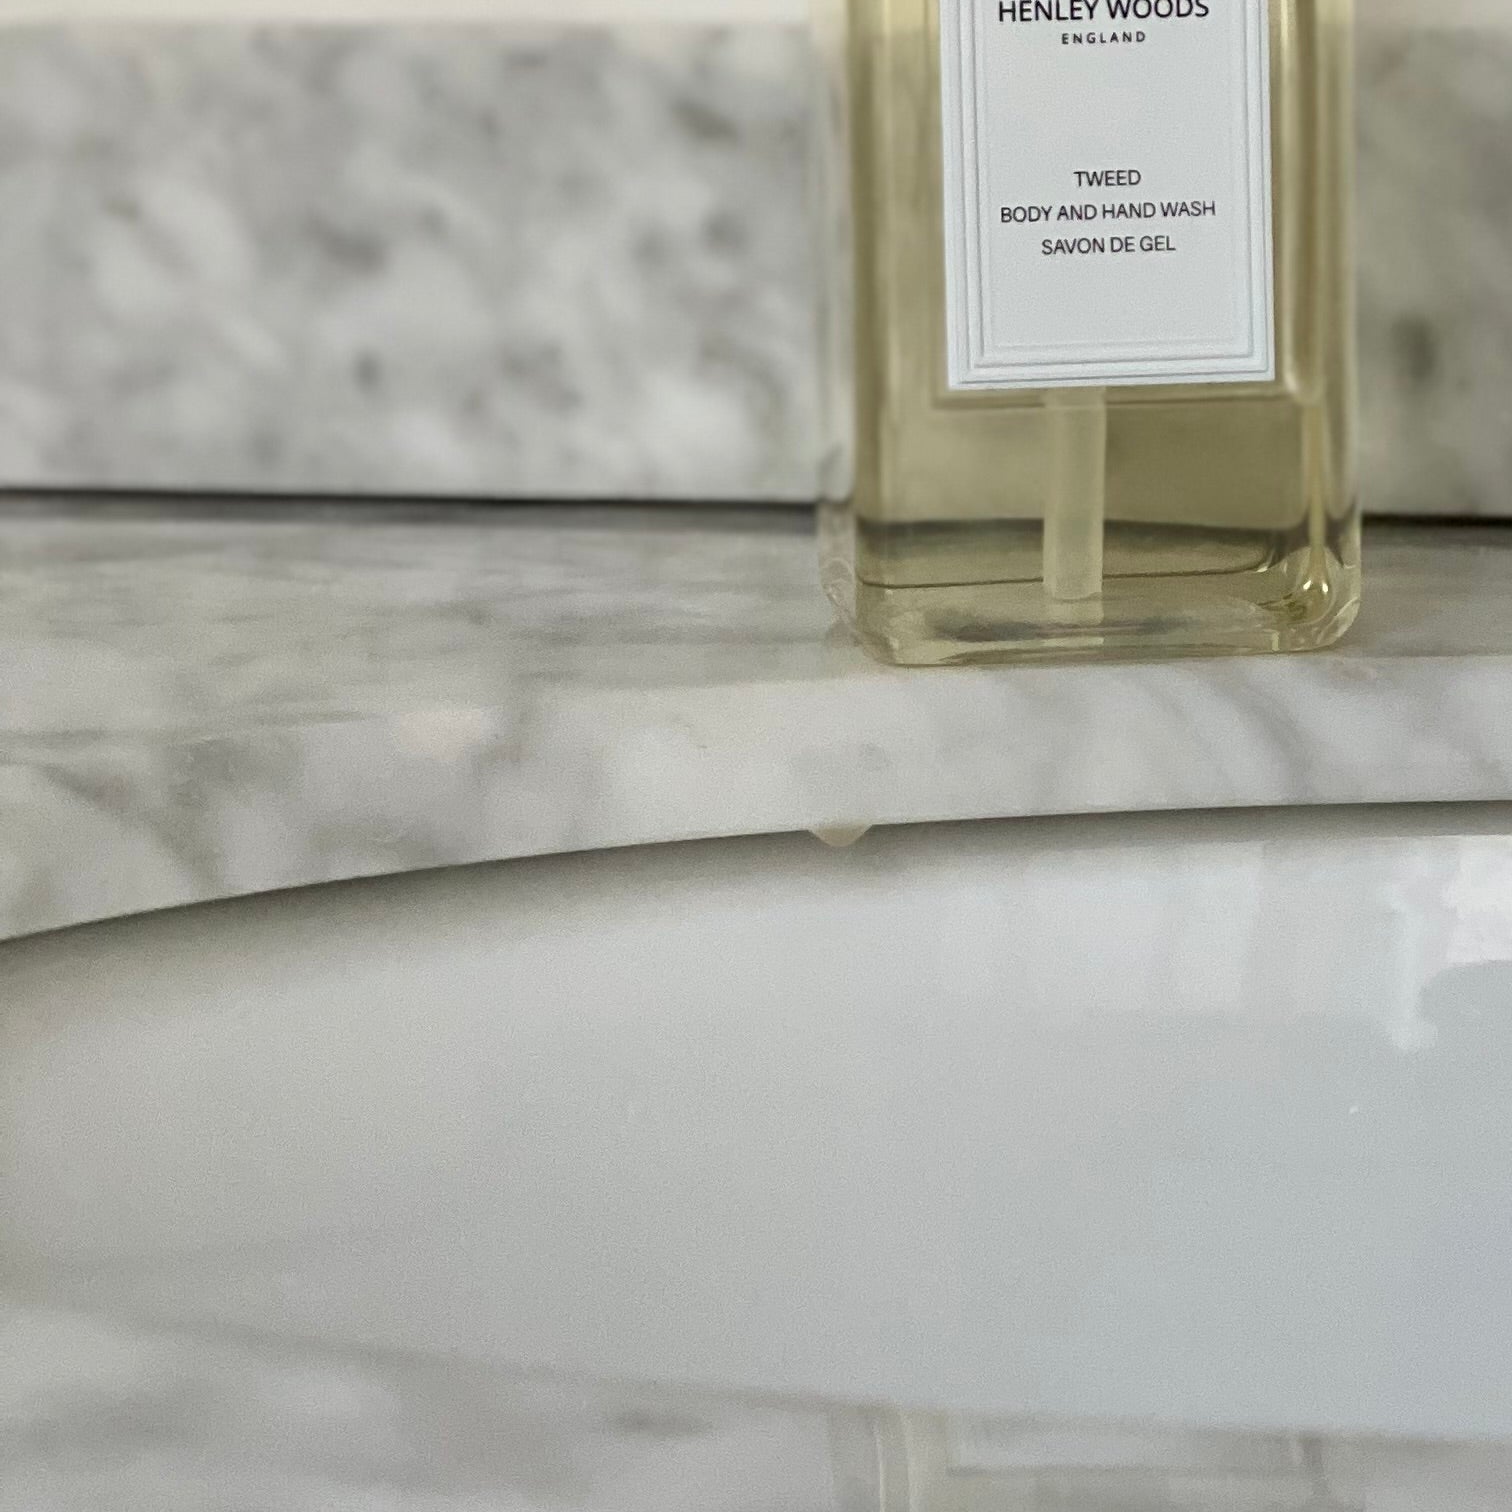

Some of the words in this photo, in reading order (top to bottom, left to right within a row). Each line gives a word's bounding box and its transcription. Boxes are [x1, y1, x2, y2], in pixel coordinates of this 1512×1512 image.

[1060, 30, 1147, 46] ENGLAND
[1072, 169, 1142, 188] TWEED
[1000, 205, 1053, 224] BODY
[1056, 203, 1098, 222] AND
[1101, 201, 1157, 221] HAND
[1159, 199, 1217, 218] WASH
[1041, 237, 1106, 256] SAVON
[1109, 235, 1136, 254] DE
[1139, 234, 1177, 253] GEL
